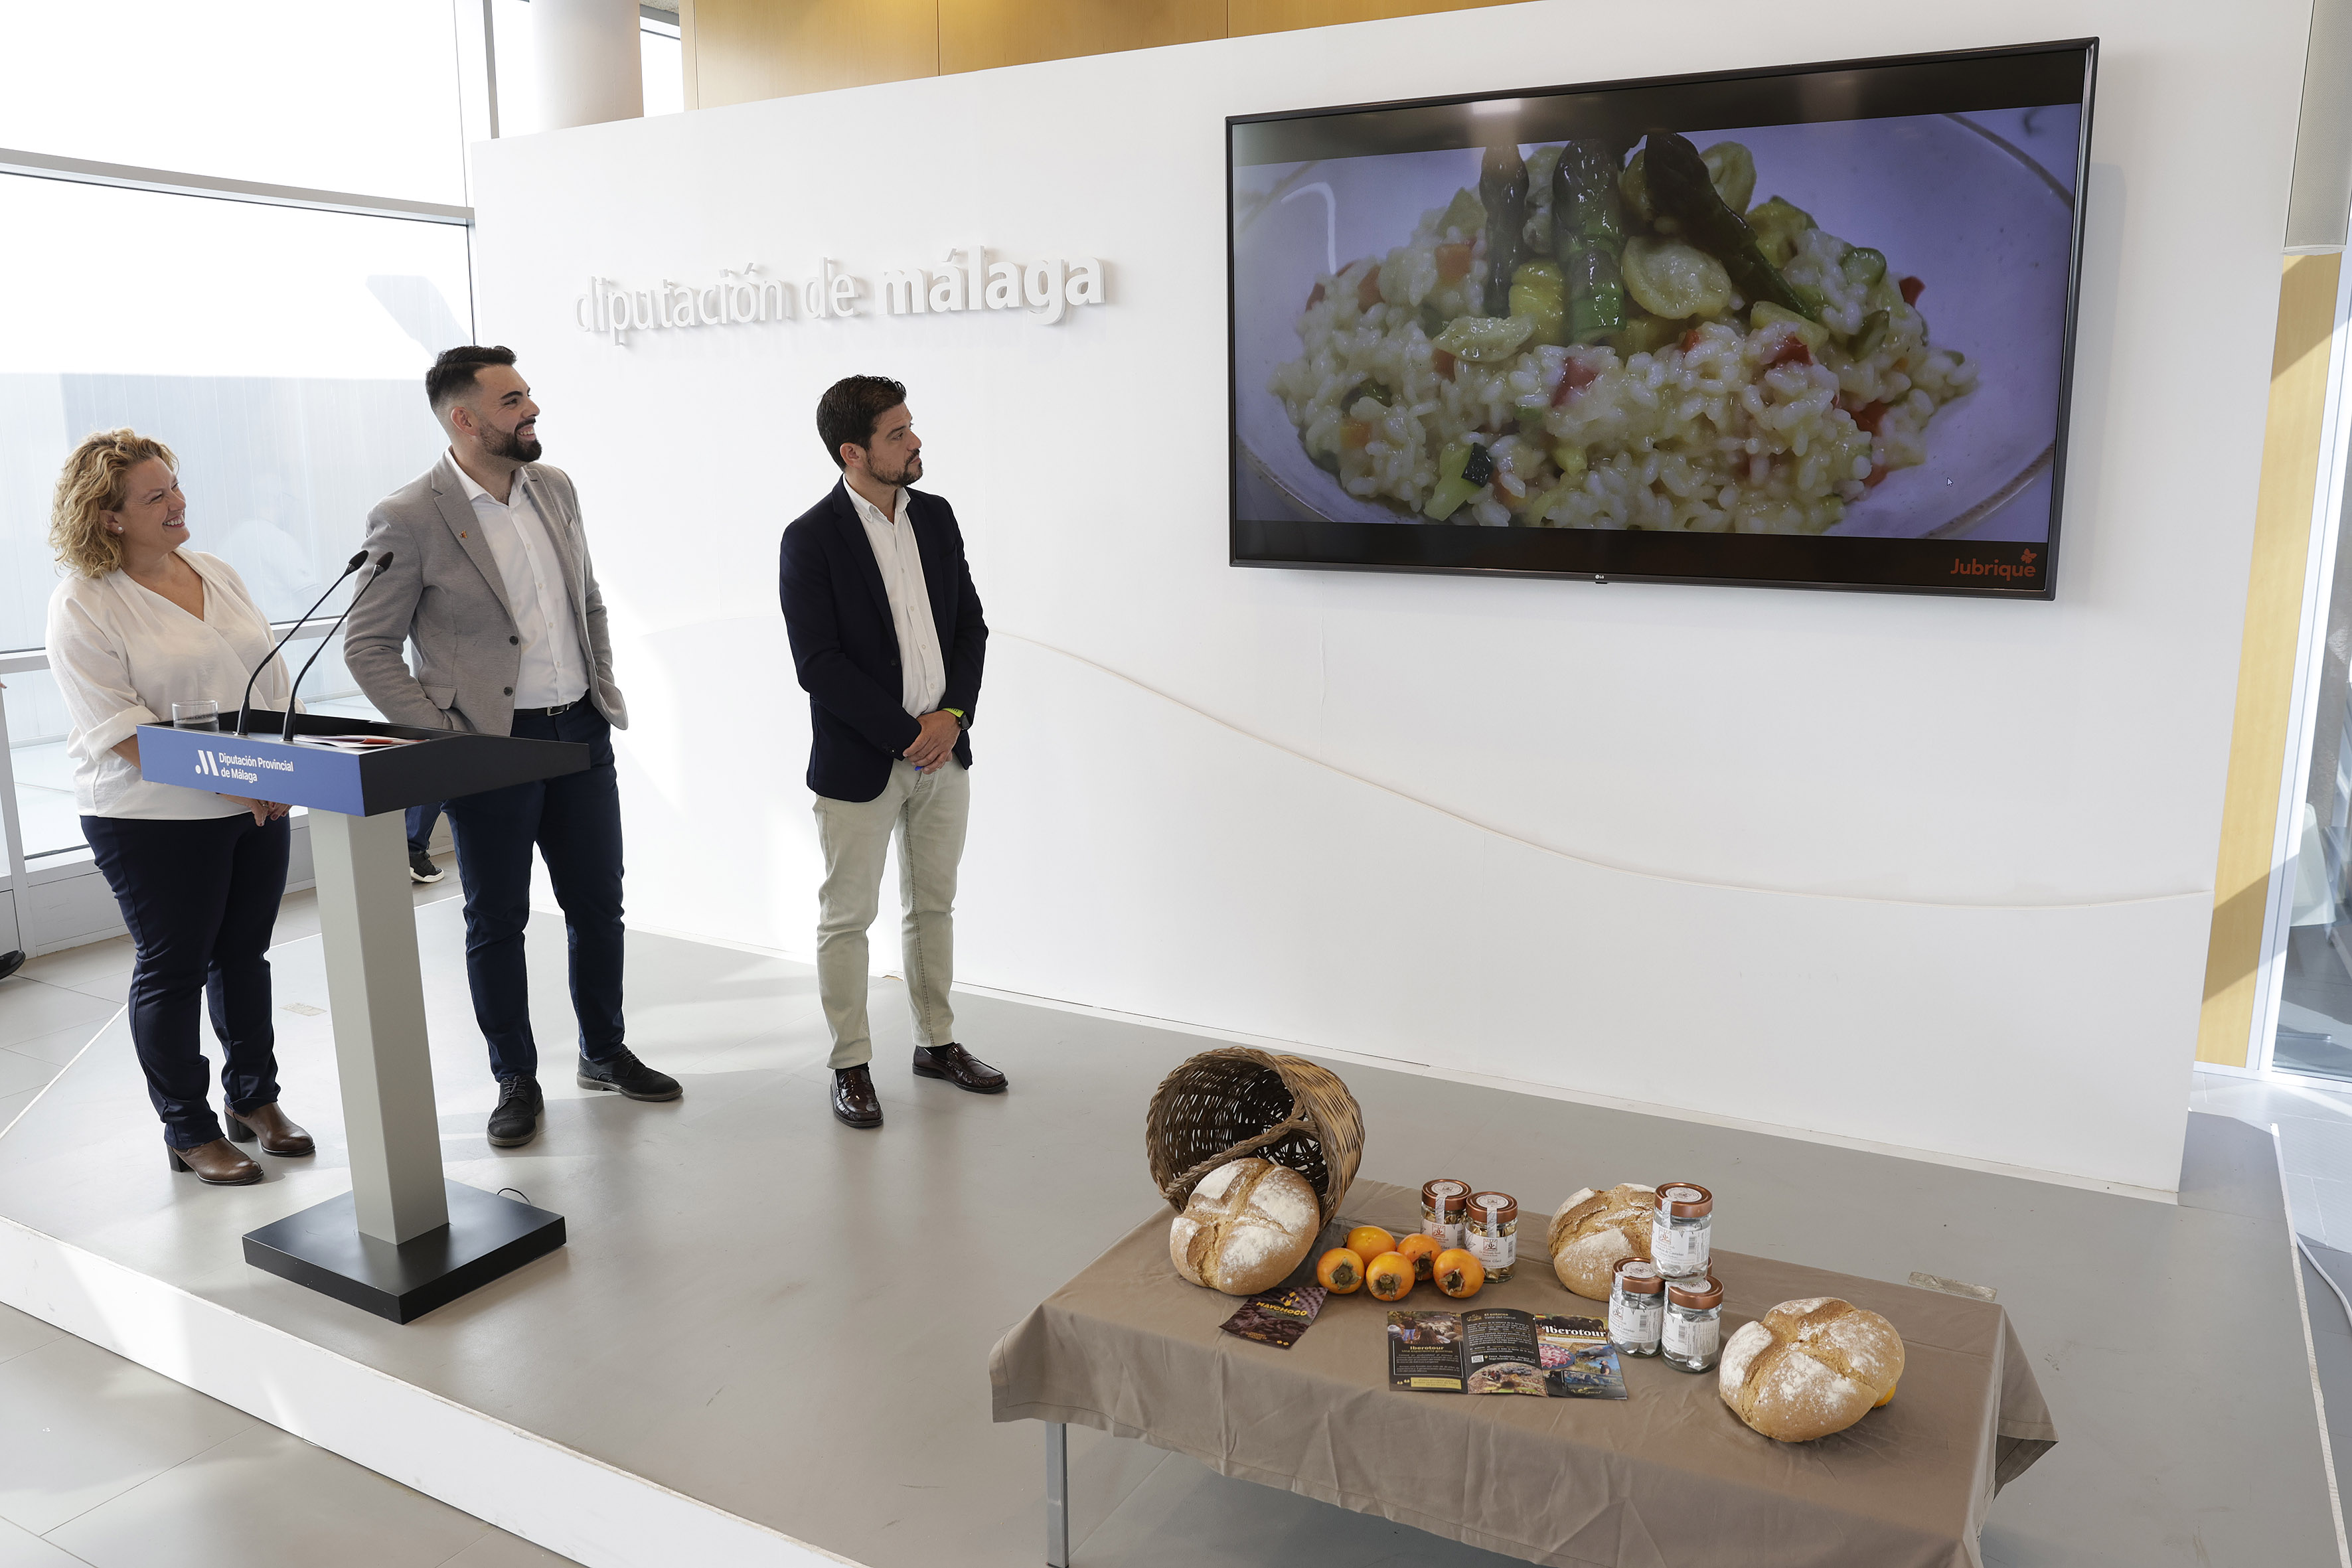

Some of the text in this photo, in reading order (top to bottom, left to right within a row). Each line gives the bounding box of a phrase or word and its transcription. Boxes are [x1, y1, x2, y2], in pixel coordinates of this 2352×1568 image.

[574, 245, 1105, 347] diputación de málaga
[1950, 558, 2036, 581] Jubrique
[218, 752, 294, 772] Diputación Provincial
[221, 767, 258, 783] de Málaga
[1541, 1325, 1607, 1337] Iberotour
